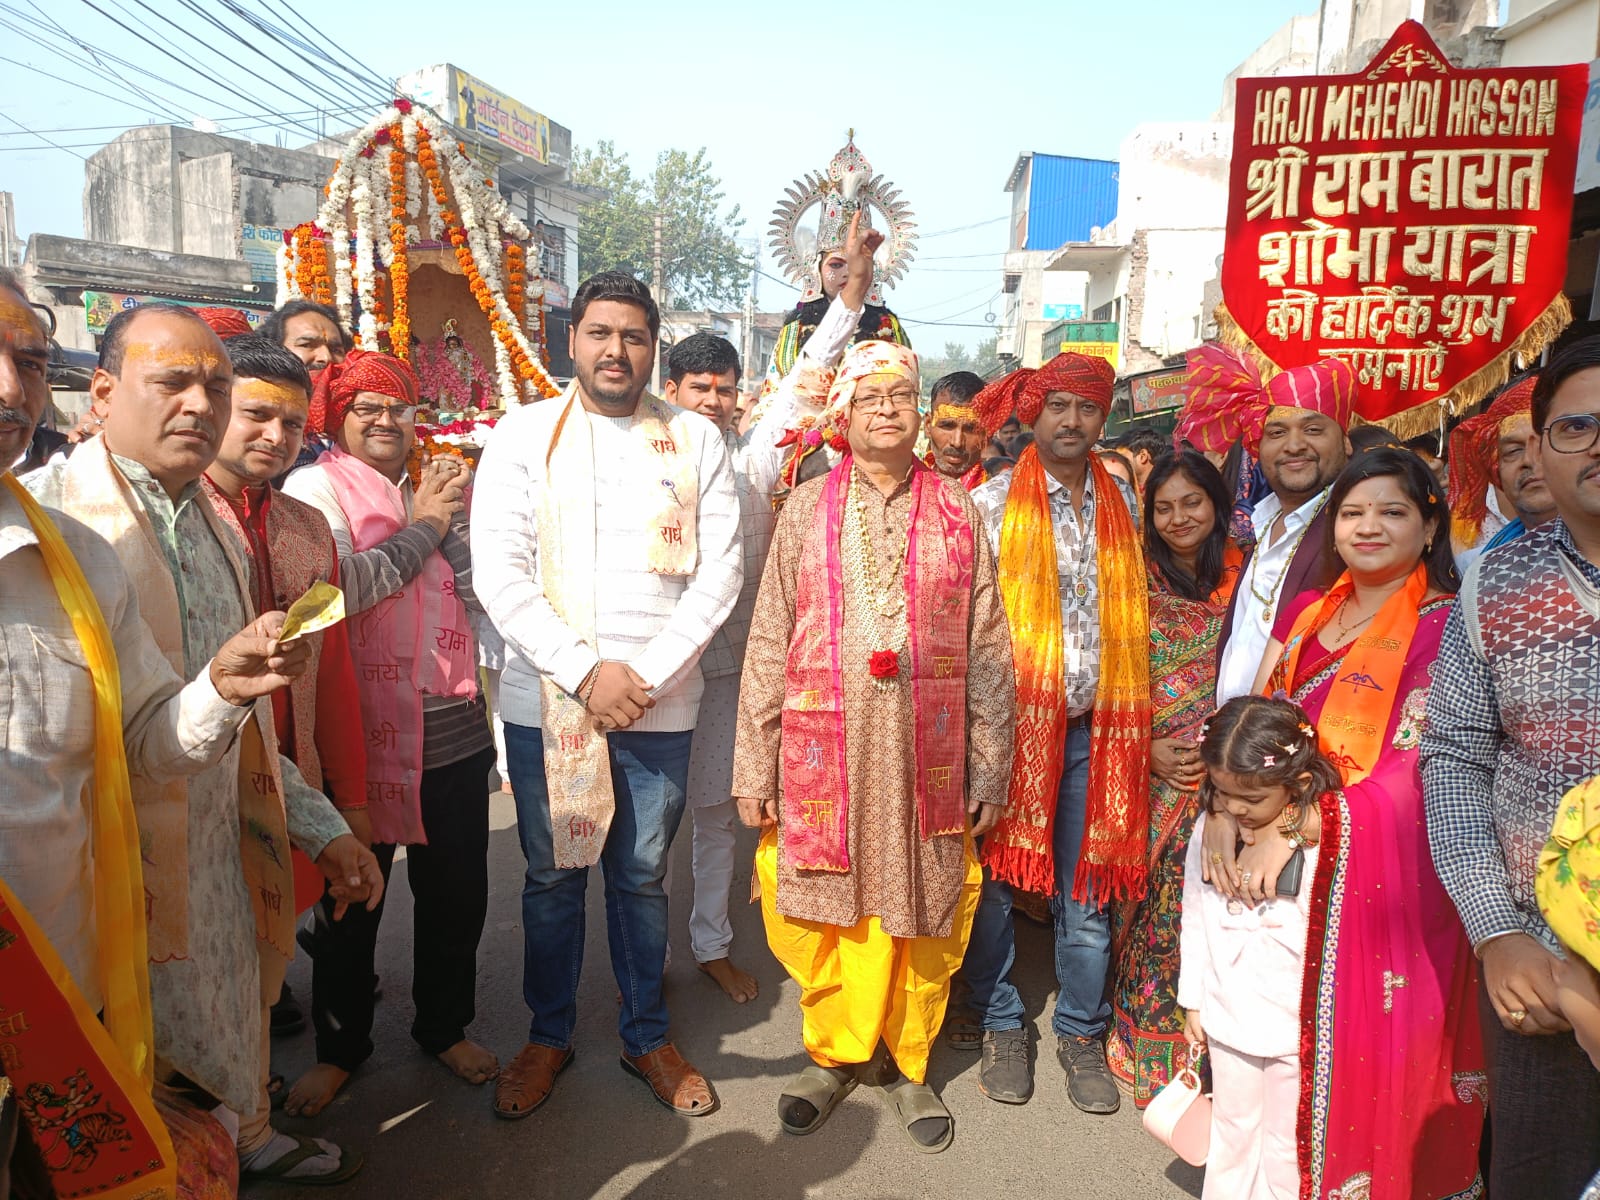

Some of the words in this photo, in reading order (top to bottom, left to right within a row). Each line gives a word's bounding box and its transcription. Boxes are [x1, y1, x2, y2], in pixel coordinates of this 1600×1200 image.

[1251, 86, 1319, 147] HAJI
[1320, 79, 1442, 143] MEHENDI
[1445, 78, 1559, 138] HASSAN
[1246, 146, 1310, 222] श्री
[1312, 150, 1407, 218] राम
[1409, 148, 1550, 212] बारात
[1259, 218, 1397, 288] शोभा
[1401, 224, 1538, 287] यात्रा
[1265, 288, 1319, 342] की
[1319, 285, 1436, 345] हार्दिक
[1439, 293, 1516, 347] शुभ
[649, 437, 678, 455] राधे
[660, 519, 683, 545] राधे
[433, 626, 469, 655] राम
[360, 663, 401, 684] जय
[934, 655, 956, 680] जय
[368, 720, 400, 750] श्री
[801, 800, 833, 827] राम
